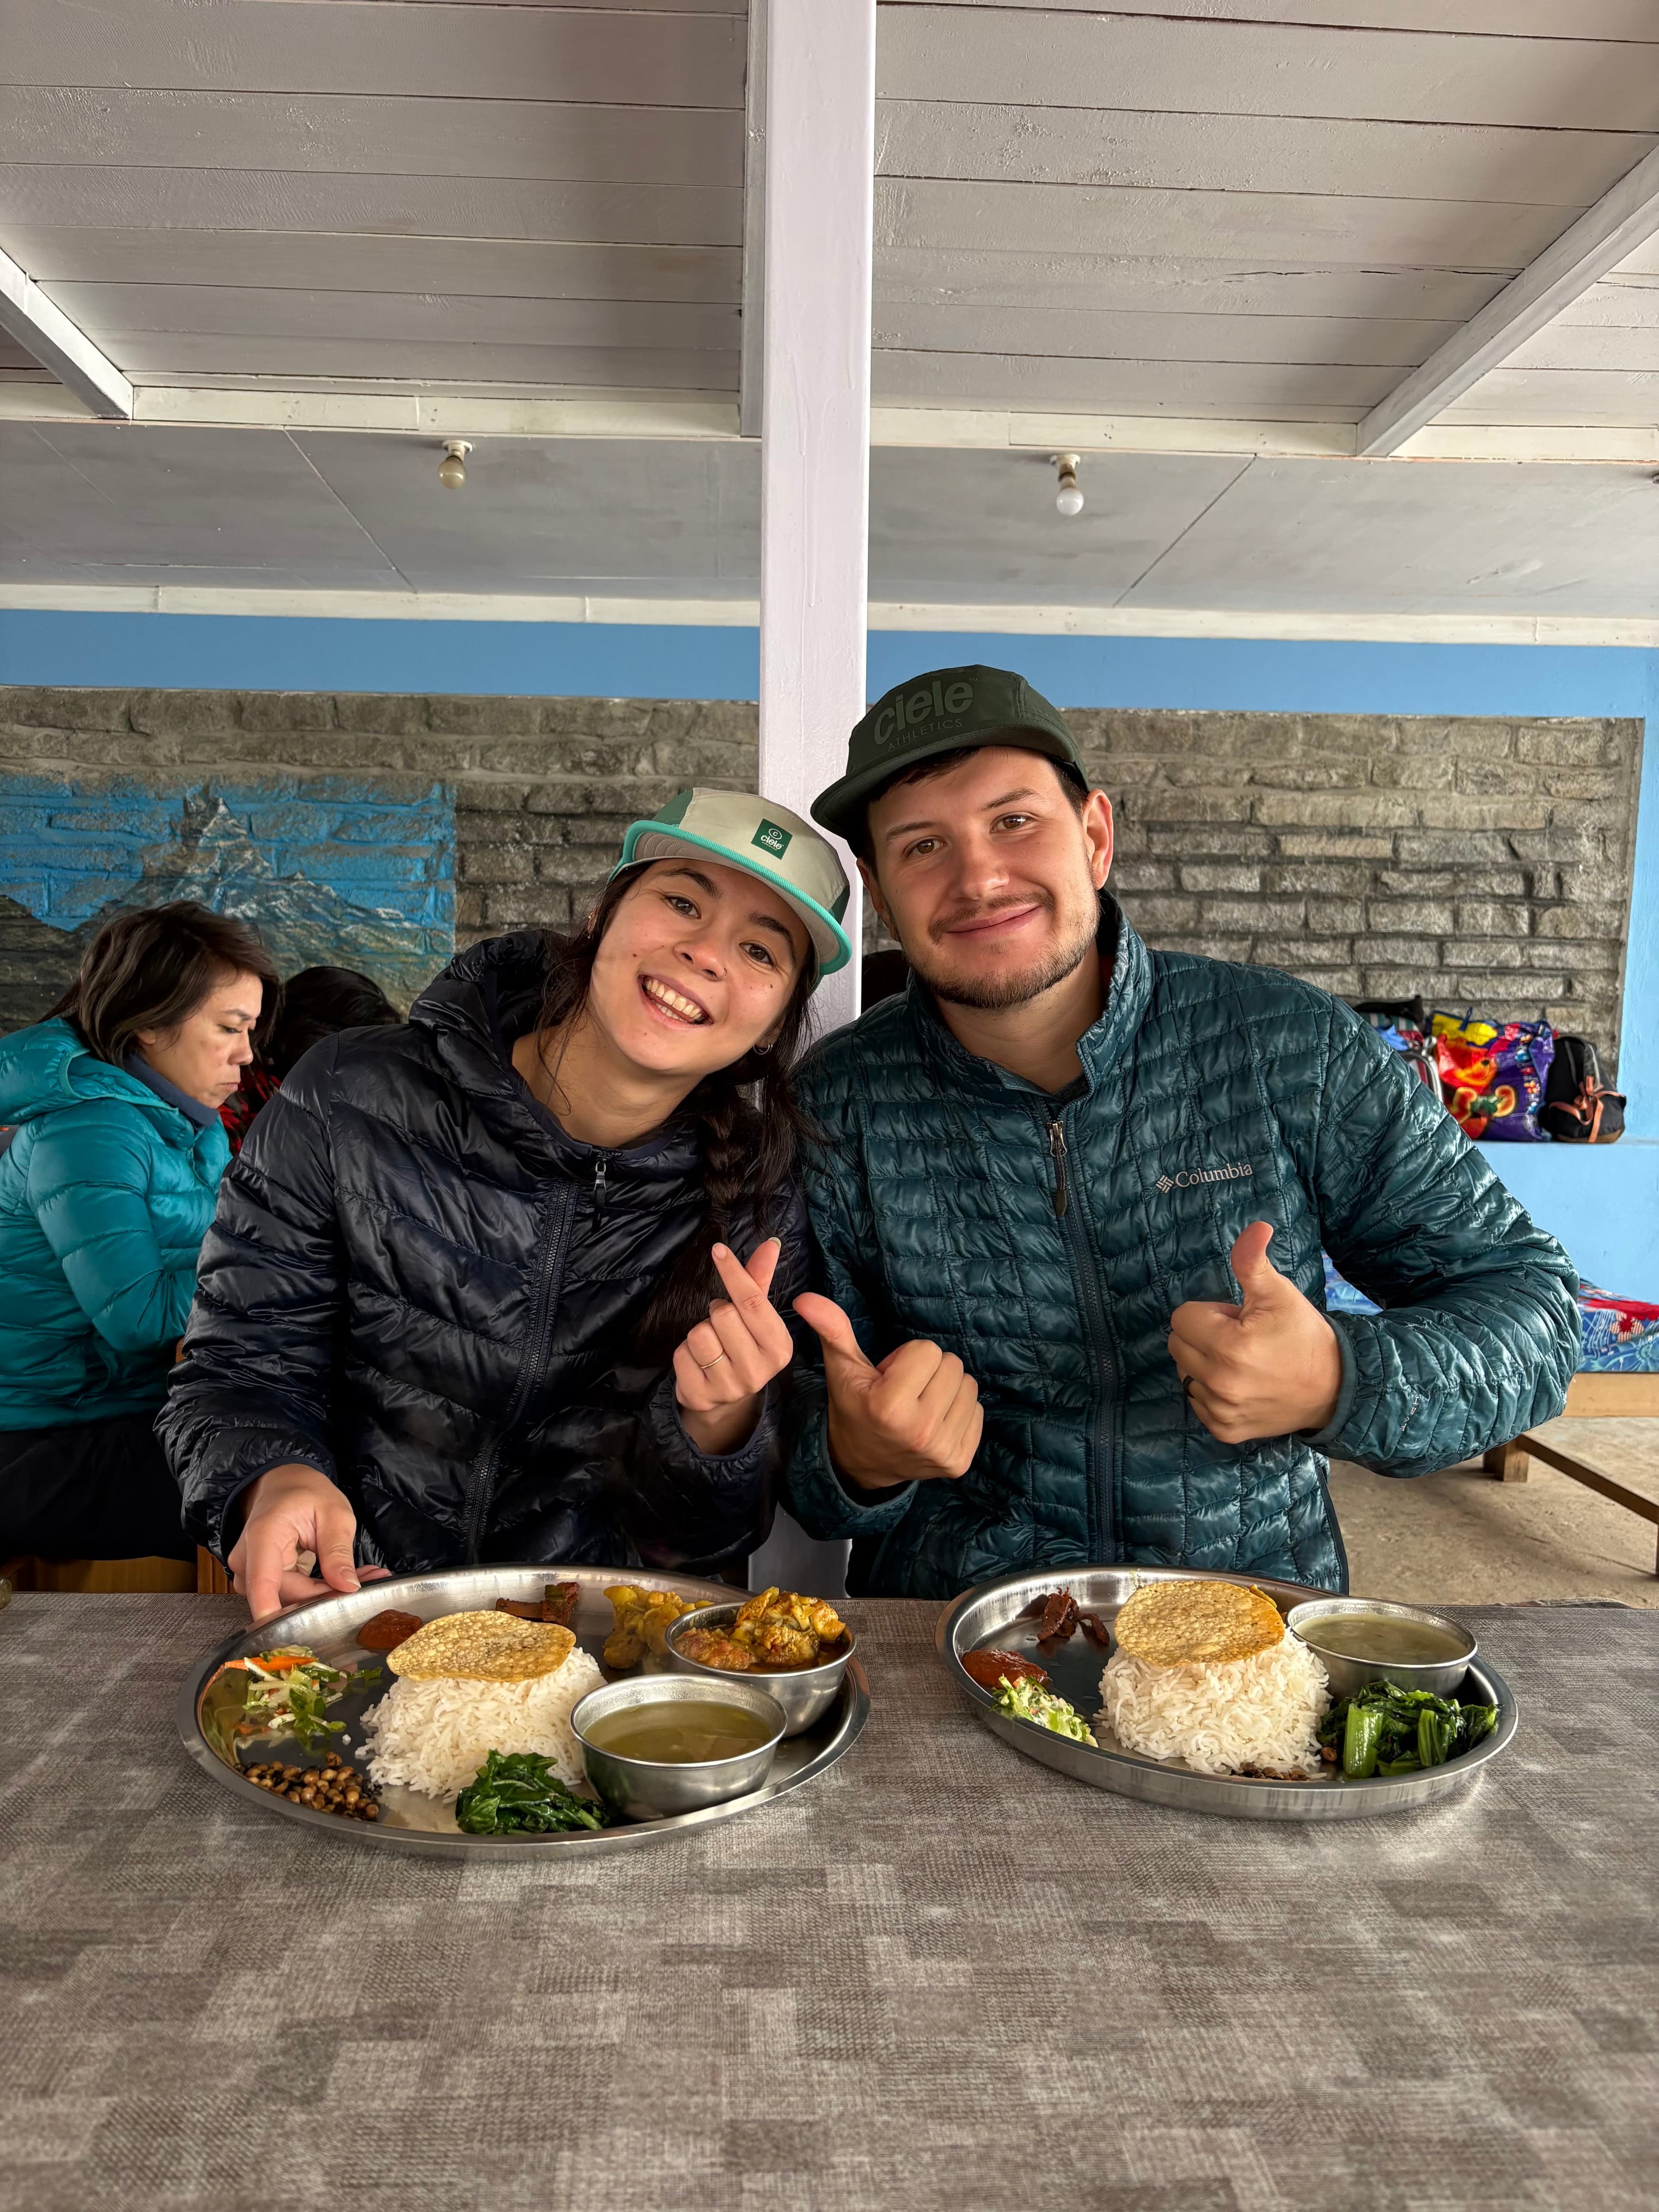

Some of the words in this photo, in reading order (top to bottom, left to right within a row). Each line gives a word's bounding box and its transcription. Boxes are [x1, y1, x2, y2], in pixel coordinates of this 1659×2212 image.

[874, 680, 974, 745] ciele
[888, 718, 963, 752] ATHLETICS
[1175, 1162, 1253, 1188] Columbia
